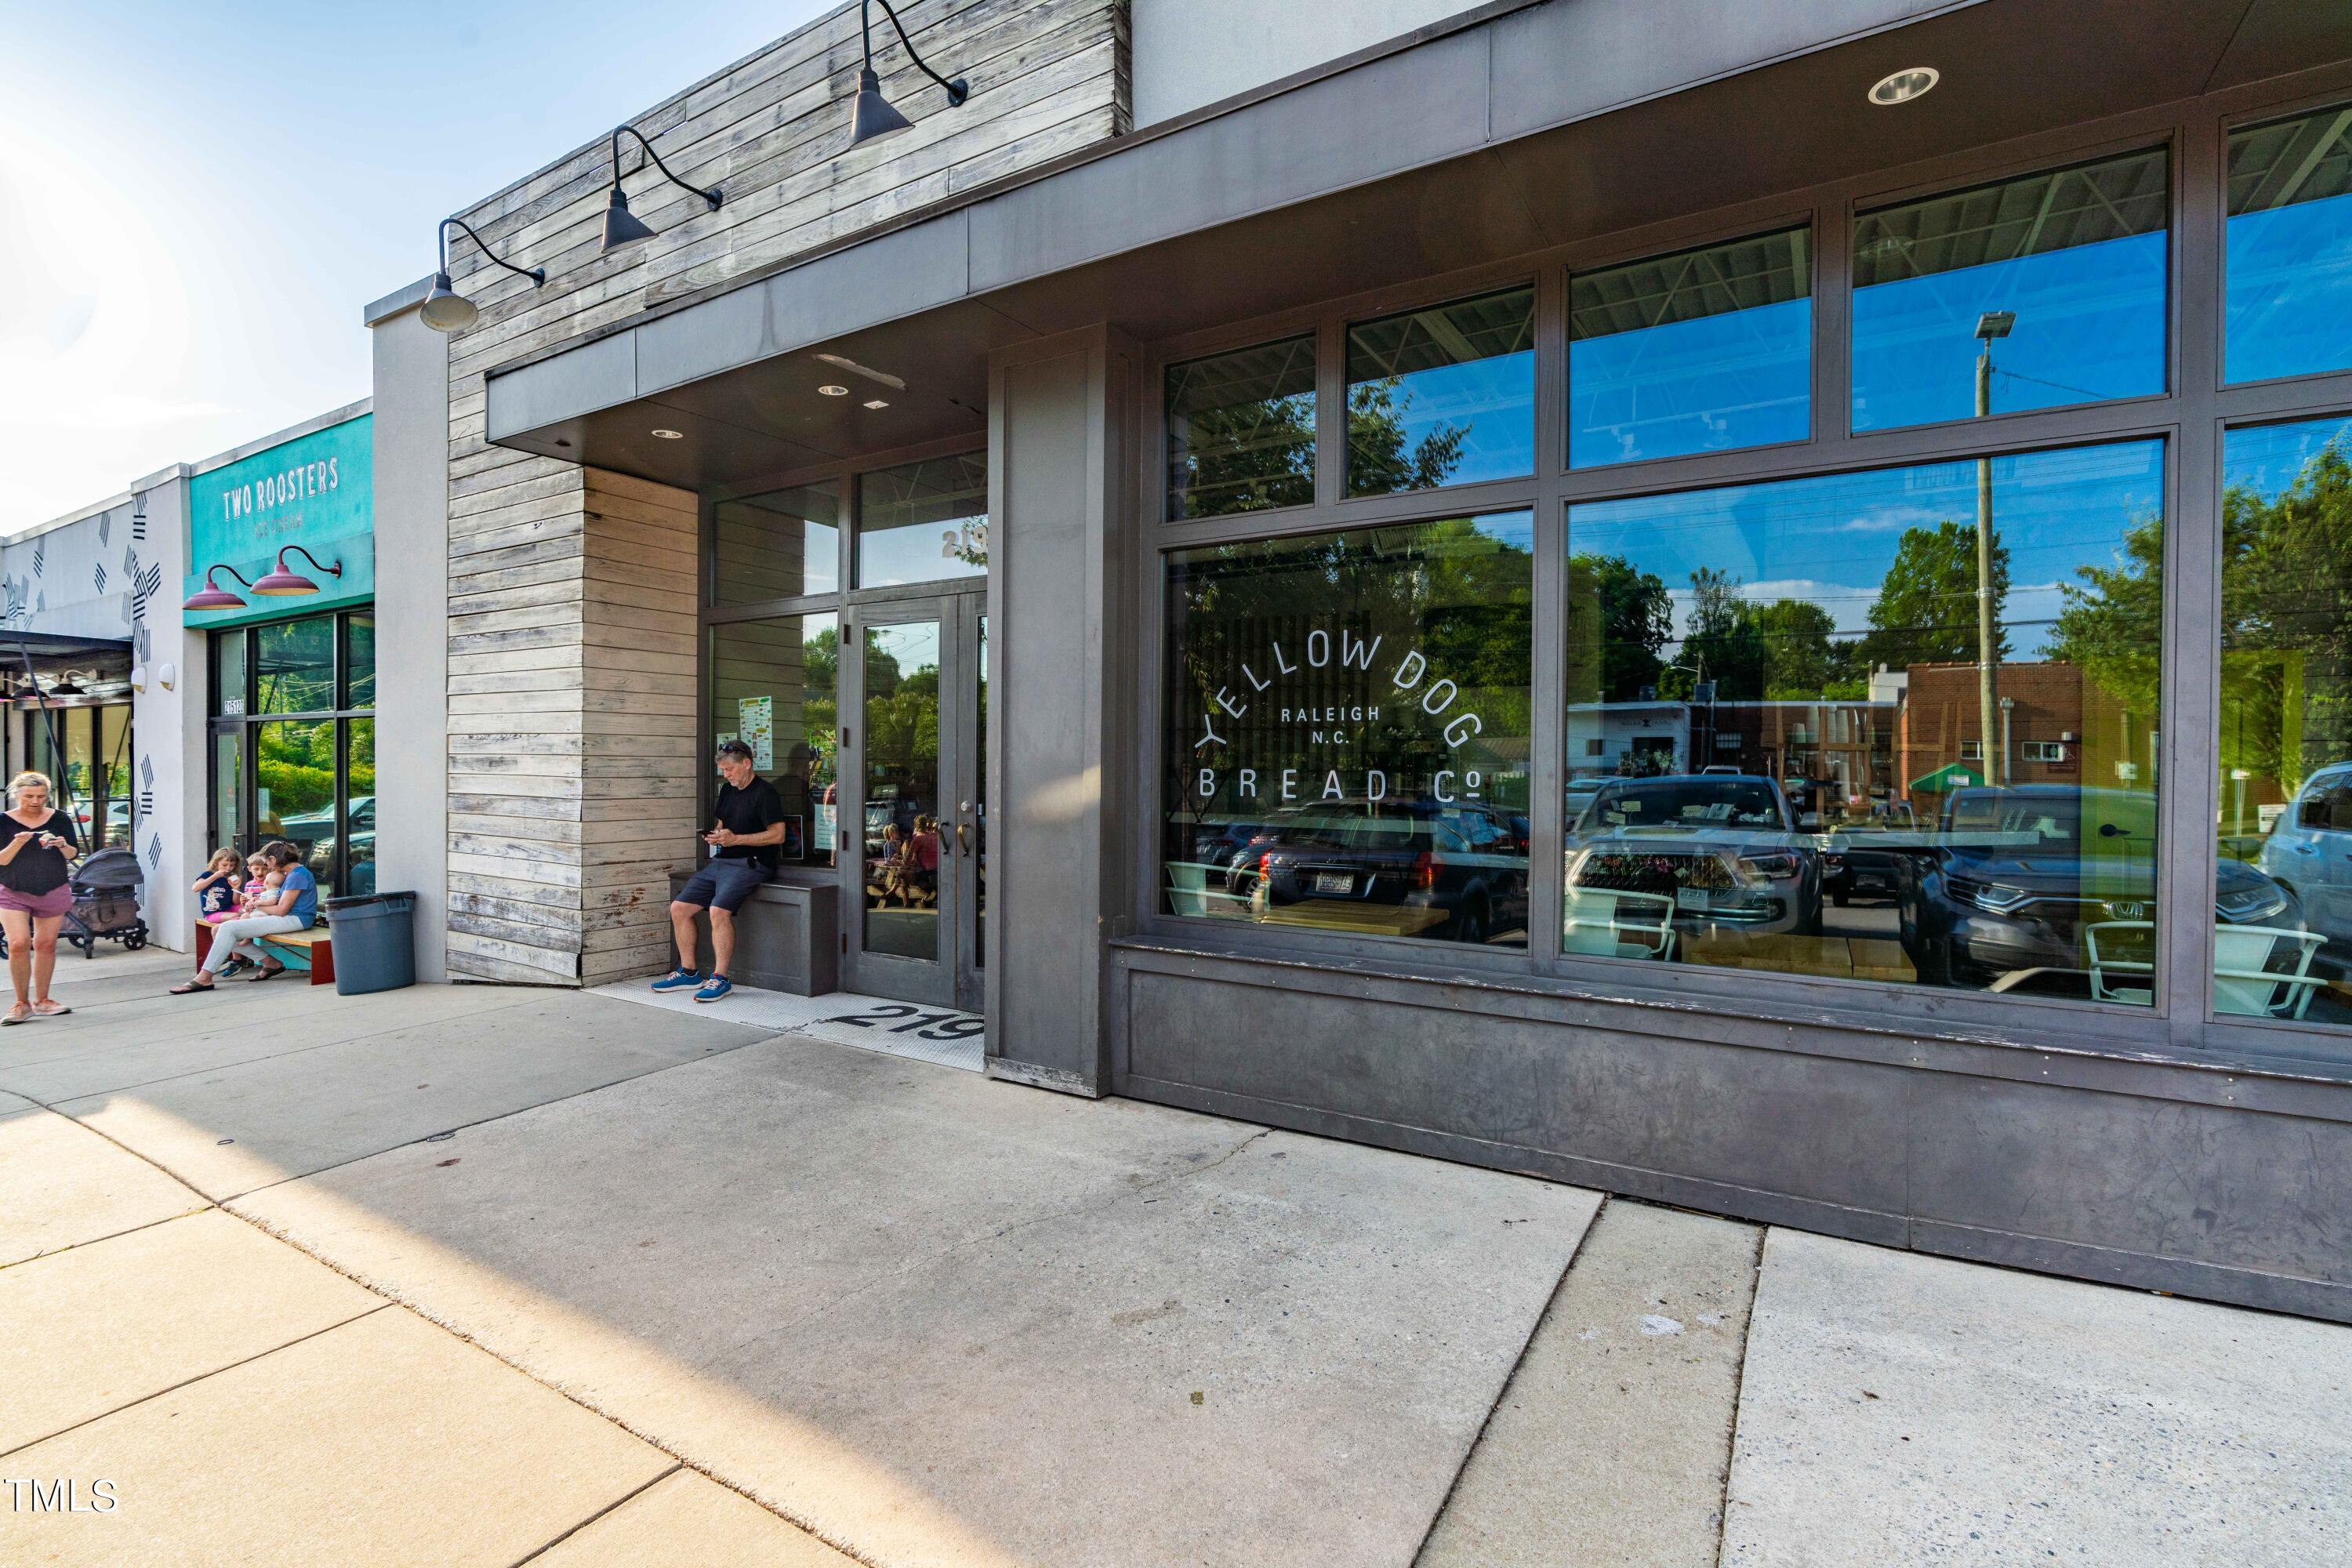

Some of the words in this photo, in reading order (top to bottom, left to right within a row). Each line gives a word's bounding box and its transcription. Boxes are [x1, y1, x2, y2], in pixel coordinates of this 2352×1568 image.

[223, 484, 252, 521] TWO
[256, 456, 339, 512] ROOSTERS
[942, 525, 988, 558] 219
[1194, 629, 1382, 749] YELLOW
[1392, 650, 1483, 748] DOG
[1281, 706, 1380, 722] RALEIGH
[1312, 731, 1350, 744] N.C.
[1200, 768, 1387, 801] BREAD
[829, 1005, 985, 1040] 219
